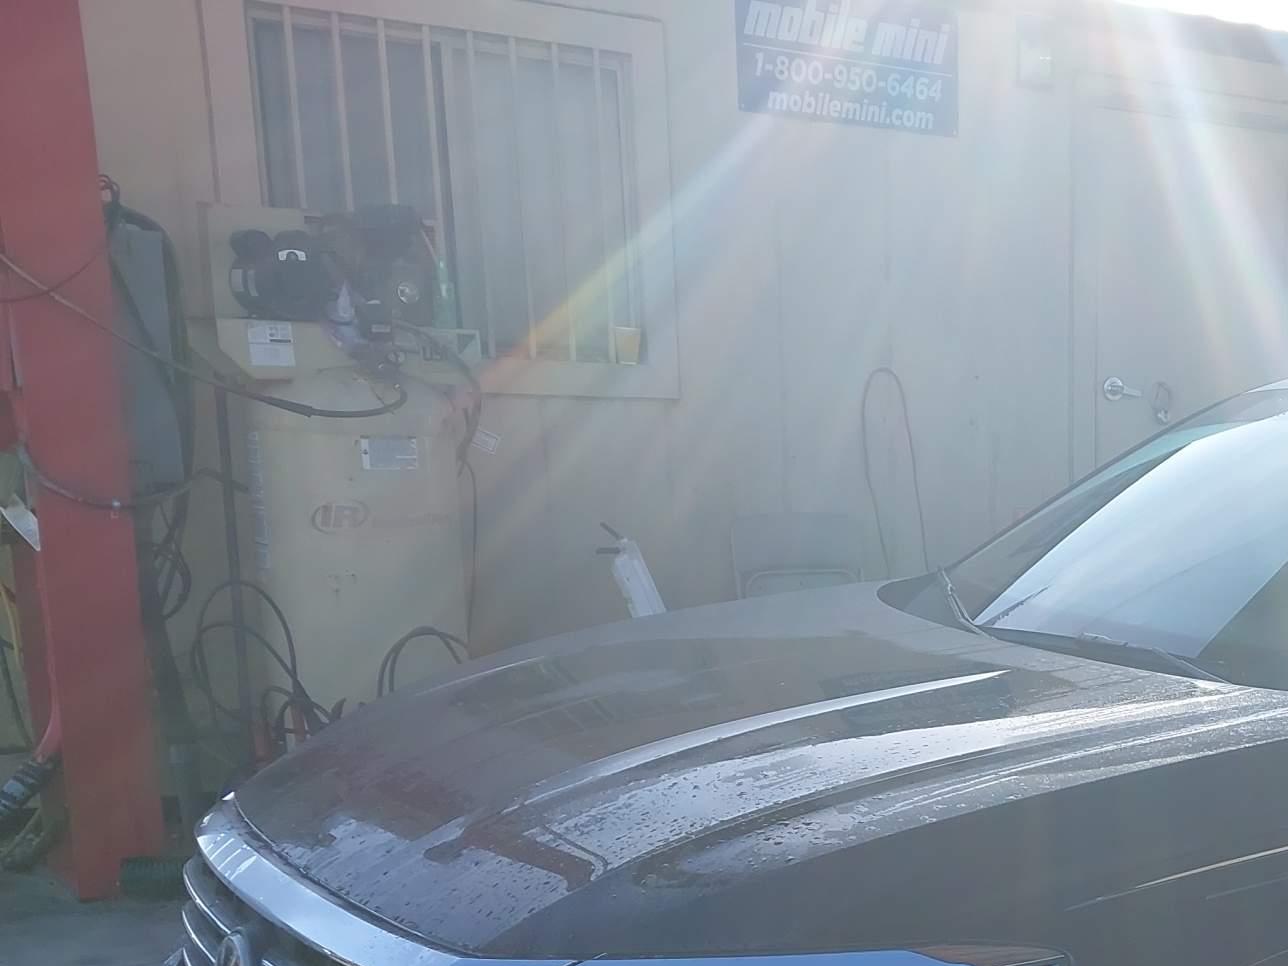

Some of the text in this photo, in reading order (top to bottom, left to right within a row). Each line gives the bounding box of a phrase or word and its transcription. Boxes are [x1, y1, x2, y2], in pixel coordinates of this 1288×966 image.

[743, 0, 952, 64] mobile mini
[754, 52, 942, 103] 1-800-950-6464
[767, 90, 935, 130] mobilemini.com
